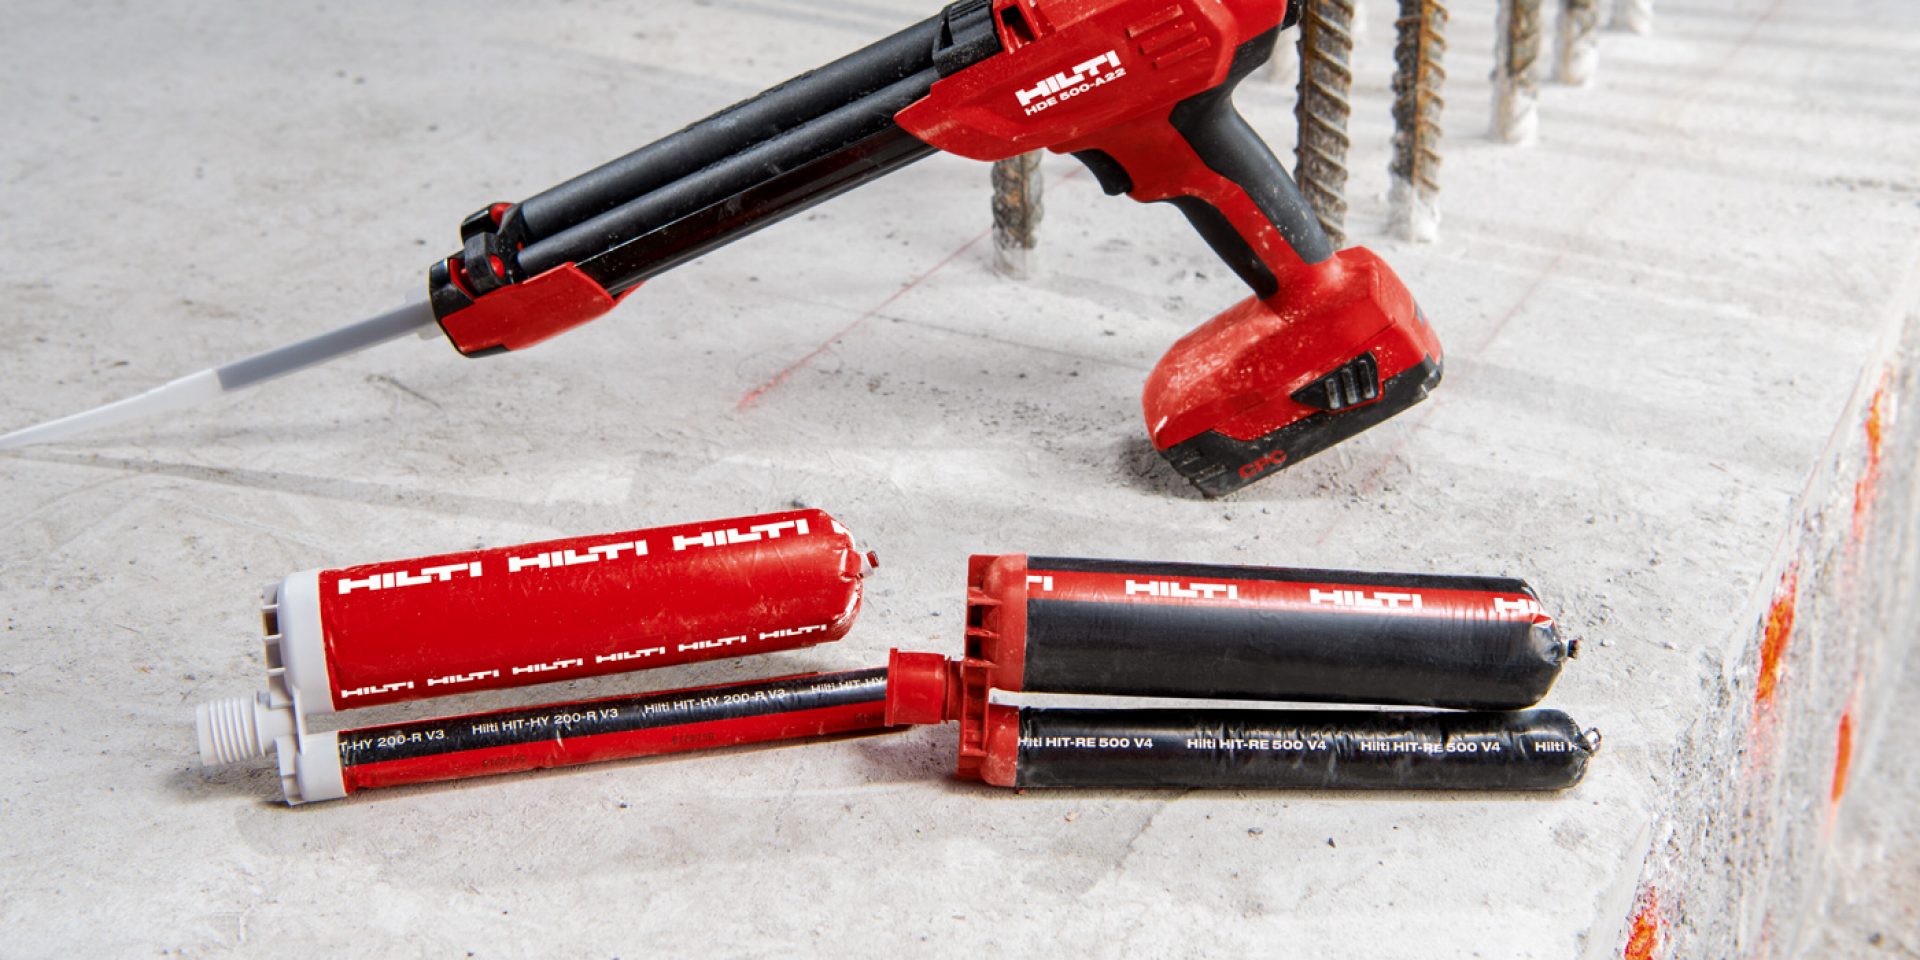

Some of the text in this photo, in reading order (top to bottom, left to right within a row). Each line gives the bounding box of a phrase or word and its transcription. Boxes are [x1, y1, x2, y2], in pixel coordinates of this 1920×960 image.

[1014, 49, 1121, 107] HILTI
[1024, 67, 1126, 116] HDE 500-A22
[1238, 450, 1287, 479] CPC
[338, 562, 482, 595] HILTI
[508, 540, 648, 572] HILTI
[673, 518, 808, 551] HILTI
[1126, 579, 1238, 600] HILTI
[1309, 588, 1422, 609] HILTI
[341, 624, 827, 698] HILTI HILTI HILTI HILTI HILTI HILTI
[810, 682, 836, 694] Hilti
[644, 689, 785, 714] Hilti HIT-HY 200-R V3
[472, 709, 618, 736] Hilti HIT-HY 200-R V3
[377, 733, 422, 749] 200-R
[425, 729, 445, 741] V3
[1045, 736, 1097, 749] HIT-RE
[1099, 736, 1130, 749] 500
[1134, 737, 1153, 749] V4
[1187, 737, 1326, 751] Hilti HIT-RE 500 V4
[1361, 740, 1501, 755] Hilti HIT-RE 500 V4
[1535, 740, 1565, 753] Hilti
